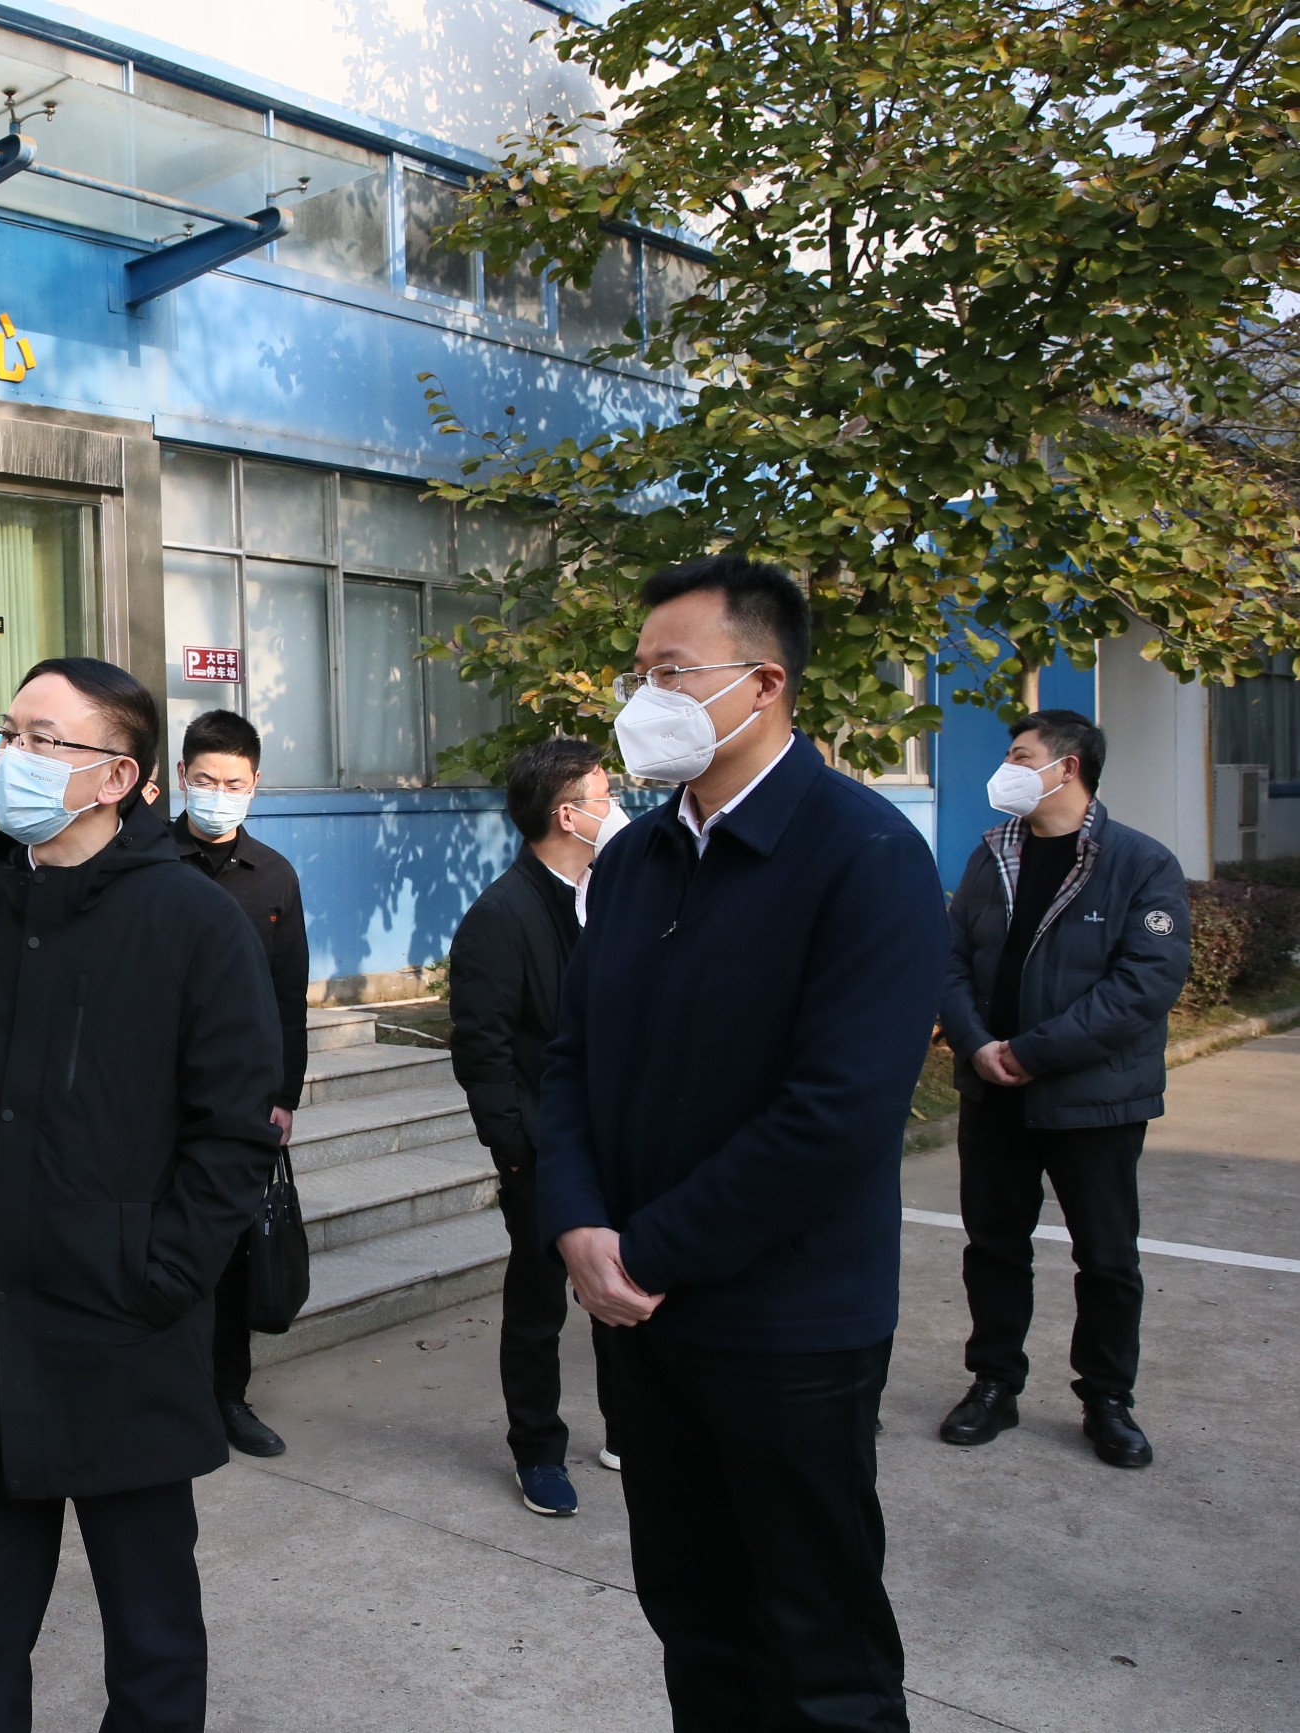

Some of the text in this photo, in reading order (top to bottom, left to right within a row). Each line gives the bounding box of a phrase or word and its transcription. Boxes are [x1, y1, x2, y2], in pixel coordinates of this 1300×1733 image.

[205, 652, 236, 665] 大巴车
[206, 665, 237, 679] 停车场
